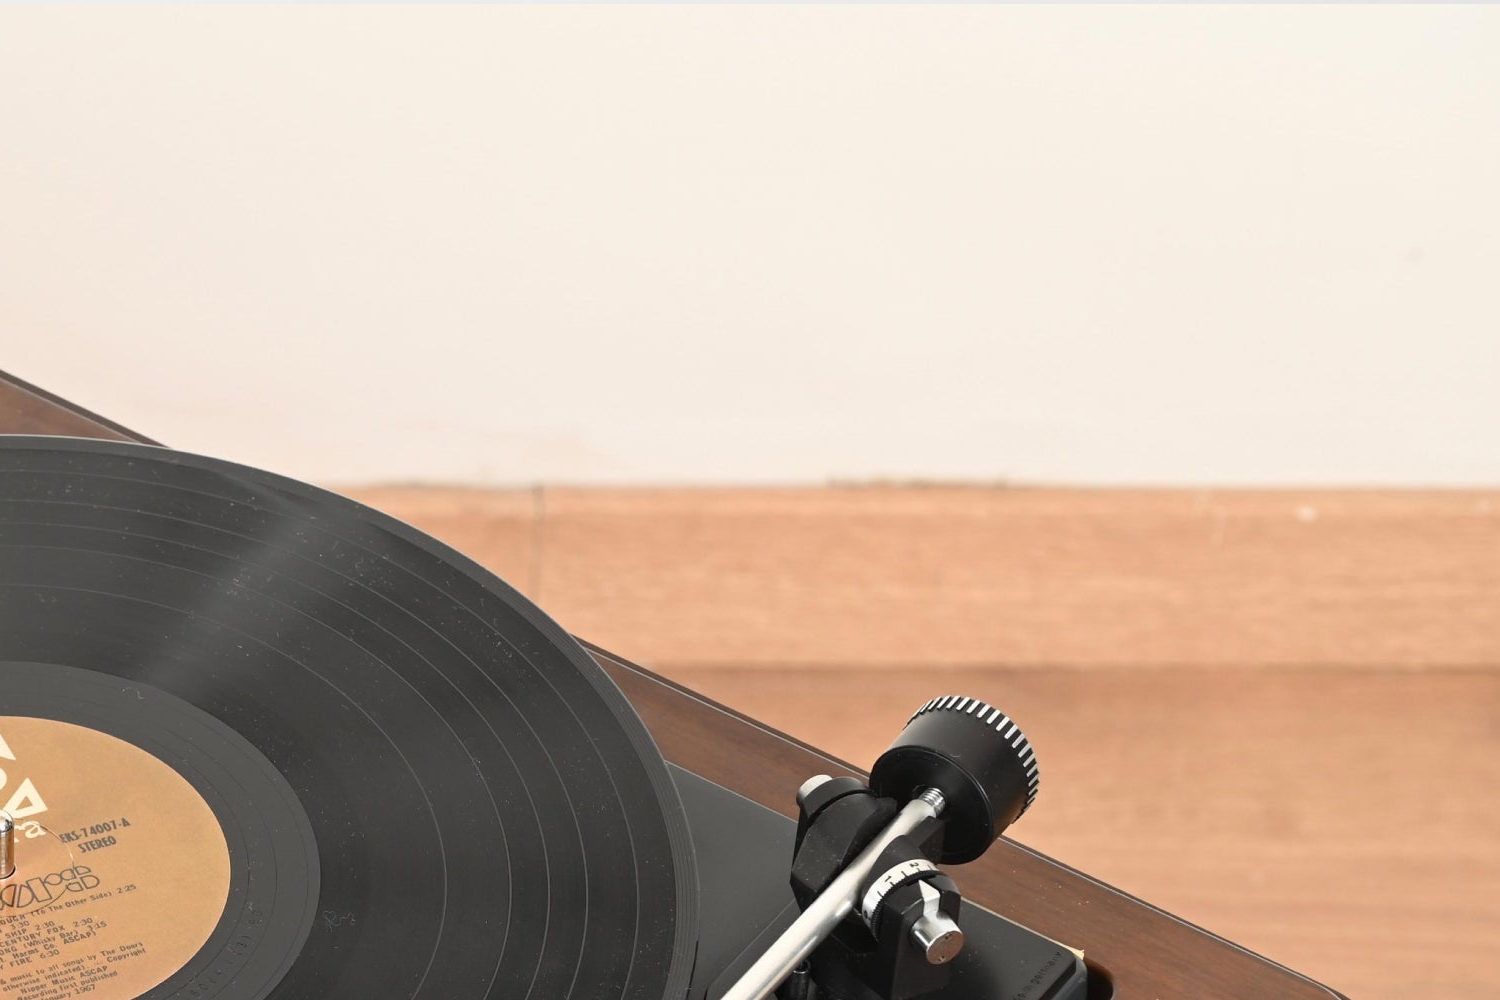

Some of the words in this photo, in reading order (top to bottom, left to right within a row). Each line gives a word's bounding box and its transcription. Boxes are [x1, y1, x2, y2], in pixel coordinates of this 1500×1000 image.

[59, 818, 131, 843] EKS-74007-A
[77, 835, 117, 853] STEREO
[49, 903, 63, 912] The
[65, 899, 87, 908] Other
[90, 891, 112, 901] Side)
[5, 928, 27, 939] SHIP
[47, 925, 65, 935] FOX
[60, 930, 79, 940] Bar)
[12, 947, 39, 959] Harms
[63, 931, 97, 944] ASCAP)
[2, 977, 40, 992] otherwise
[106, 947, 146, 963] Copyright
[10, 957, 32, 967] FIRE
[10, 973, 33, 983] music
[62, 958, 84, 968] songs
[100, 948, 116, 957] The
[119, 941, 144, 952] Doors
[20, 983, 47, 994] Nipper
[51, 975, 75, 986] Music
[79, 965, 108, 978] ASCAP
[59, 981, 77, 991] first
[80, 970, 118, 986] published
[74, 983, 96, 995] 1967
